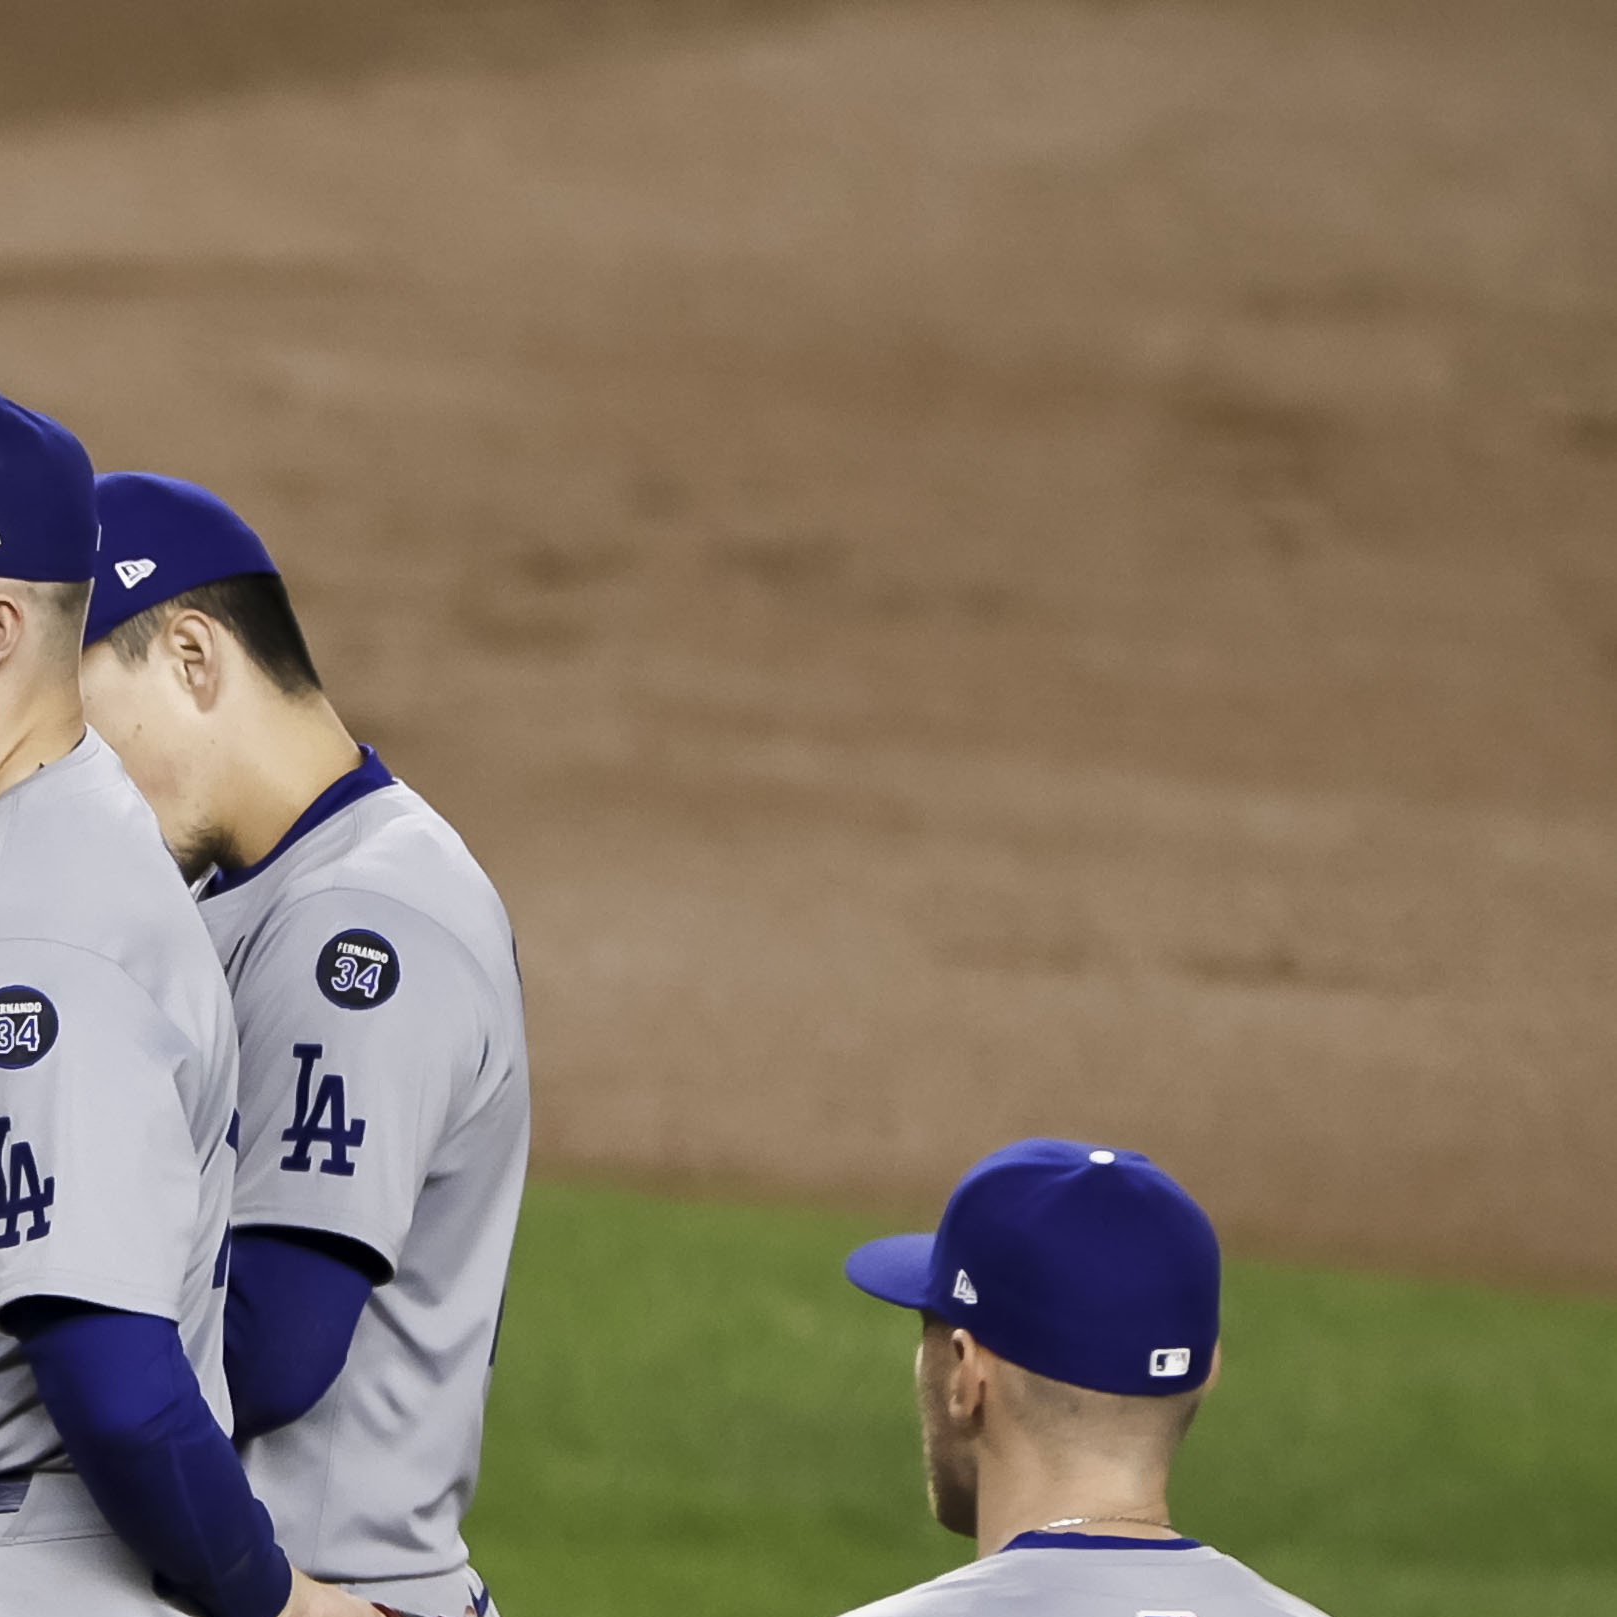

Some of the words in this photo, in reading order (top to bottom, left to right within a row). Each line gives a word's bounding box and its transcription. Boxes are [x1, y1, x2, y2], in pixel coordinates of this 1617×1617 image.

[336, 942, 389, 964] FERNANDO
[331, 956, 382, 999] 34
[280, 1042, 366, 1177] LA
